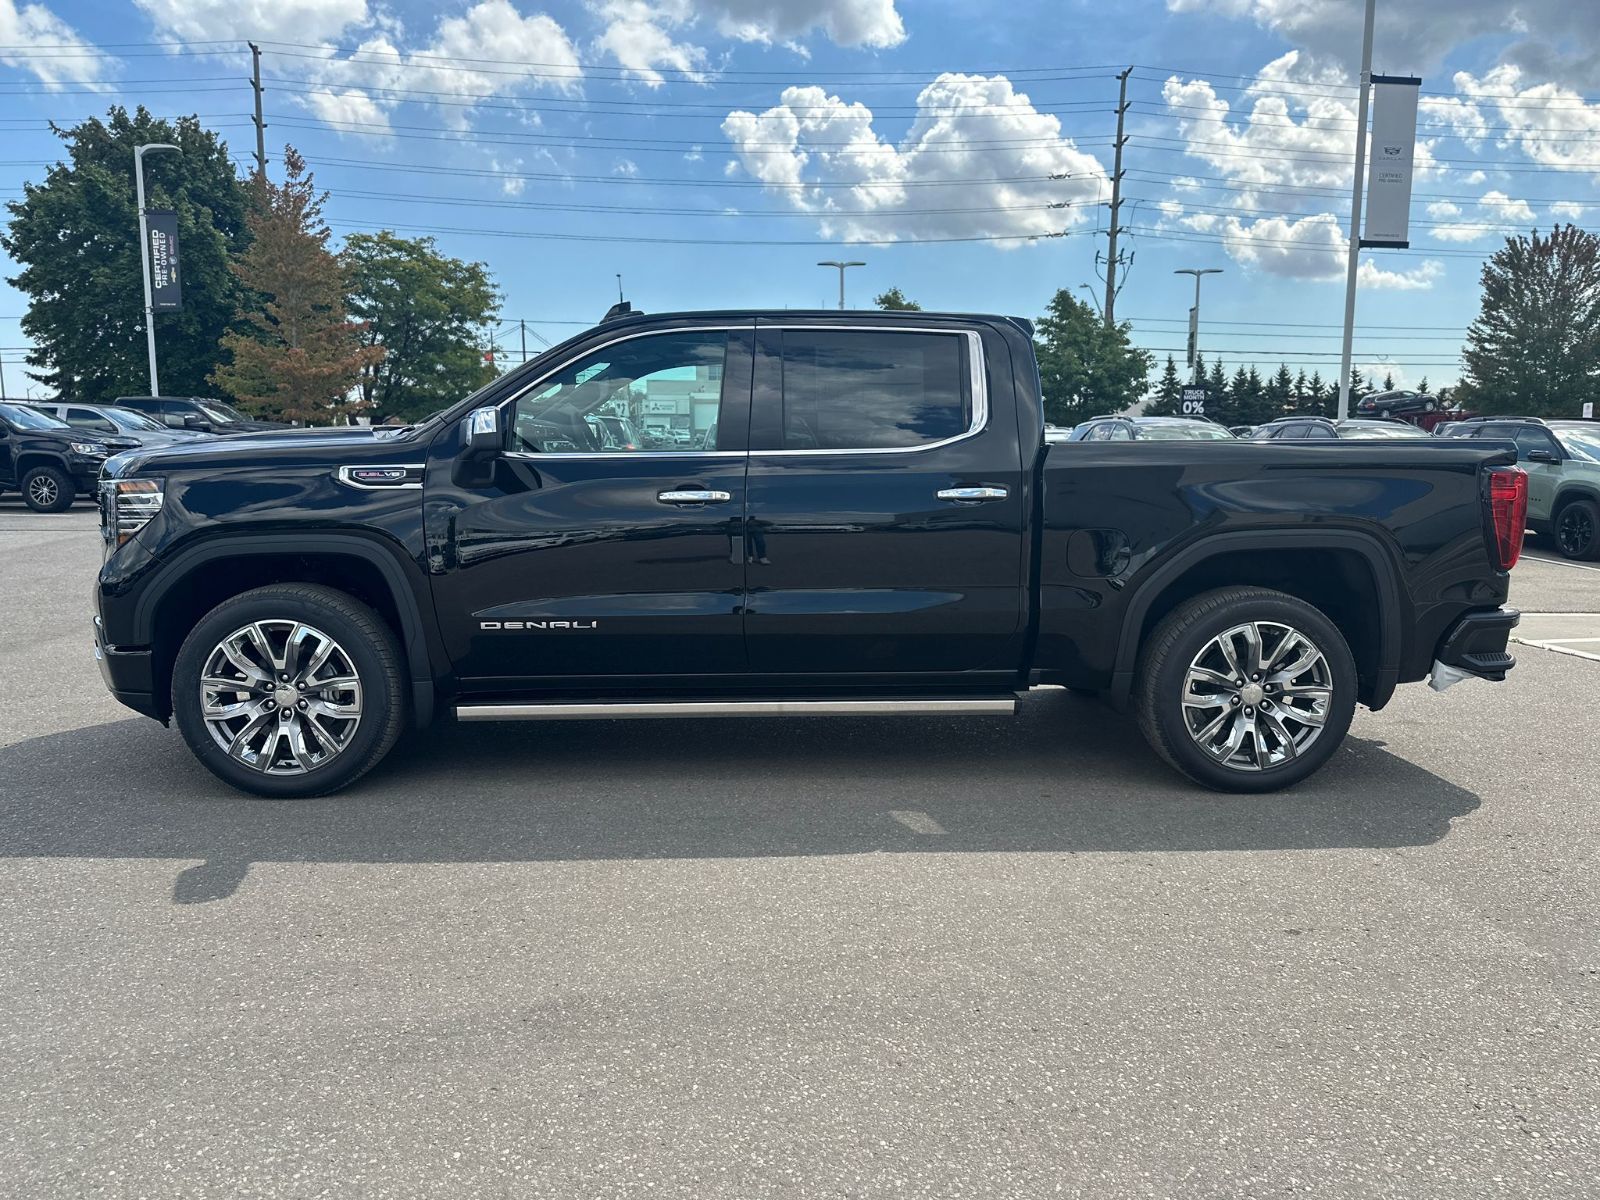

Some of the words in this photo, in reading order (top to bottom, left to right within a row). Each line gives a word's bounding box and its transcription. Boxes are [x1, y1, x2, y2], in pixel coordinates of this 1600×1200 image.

[152, 229, 162, 289] CERTIFIED
[159, 232, 168, 286] PRE-OWNED
[1183, 401, 1205, 414] 0%
[480, 620, 597, 630] DENALI
